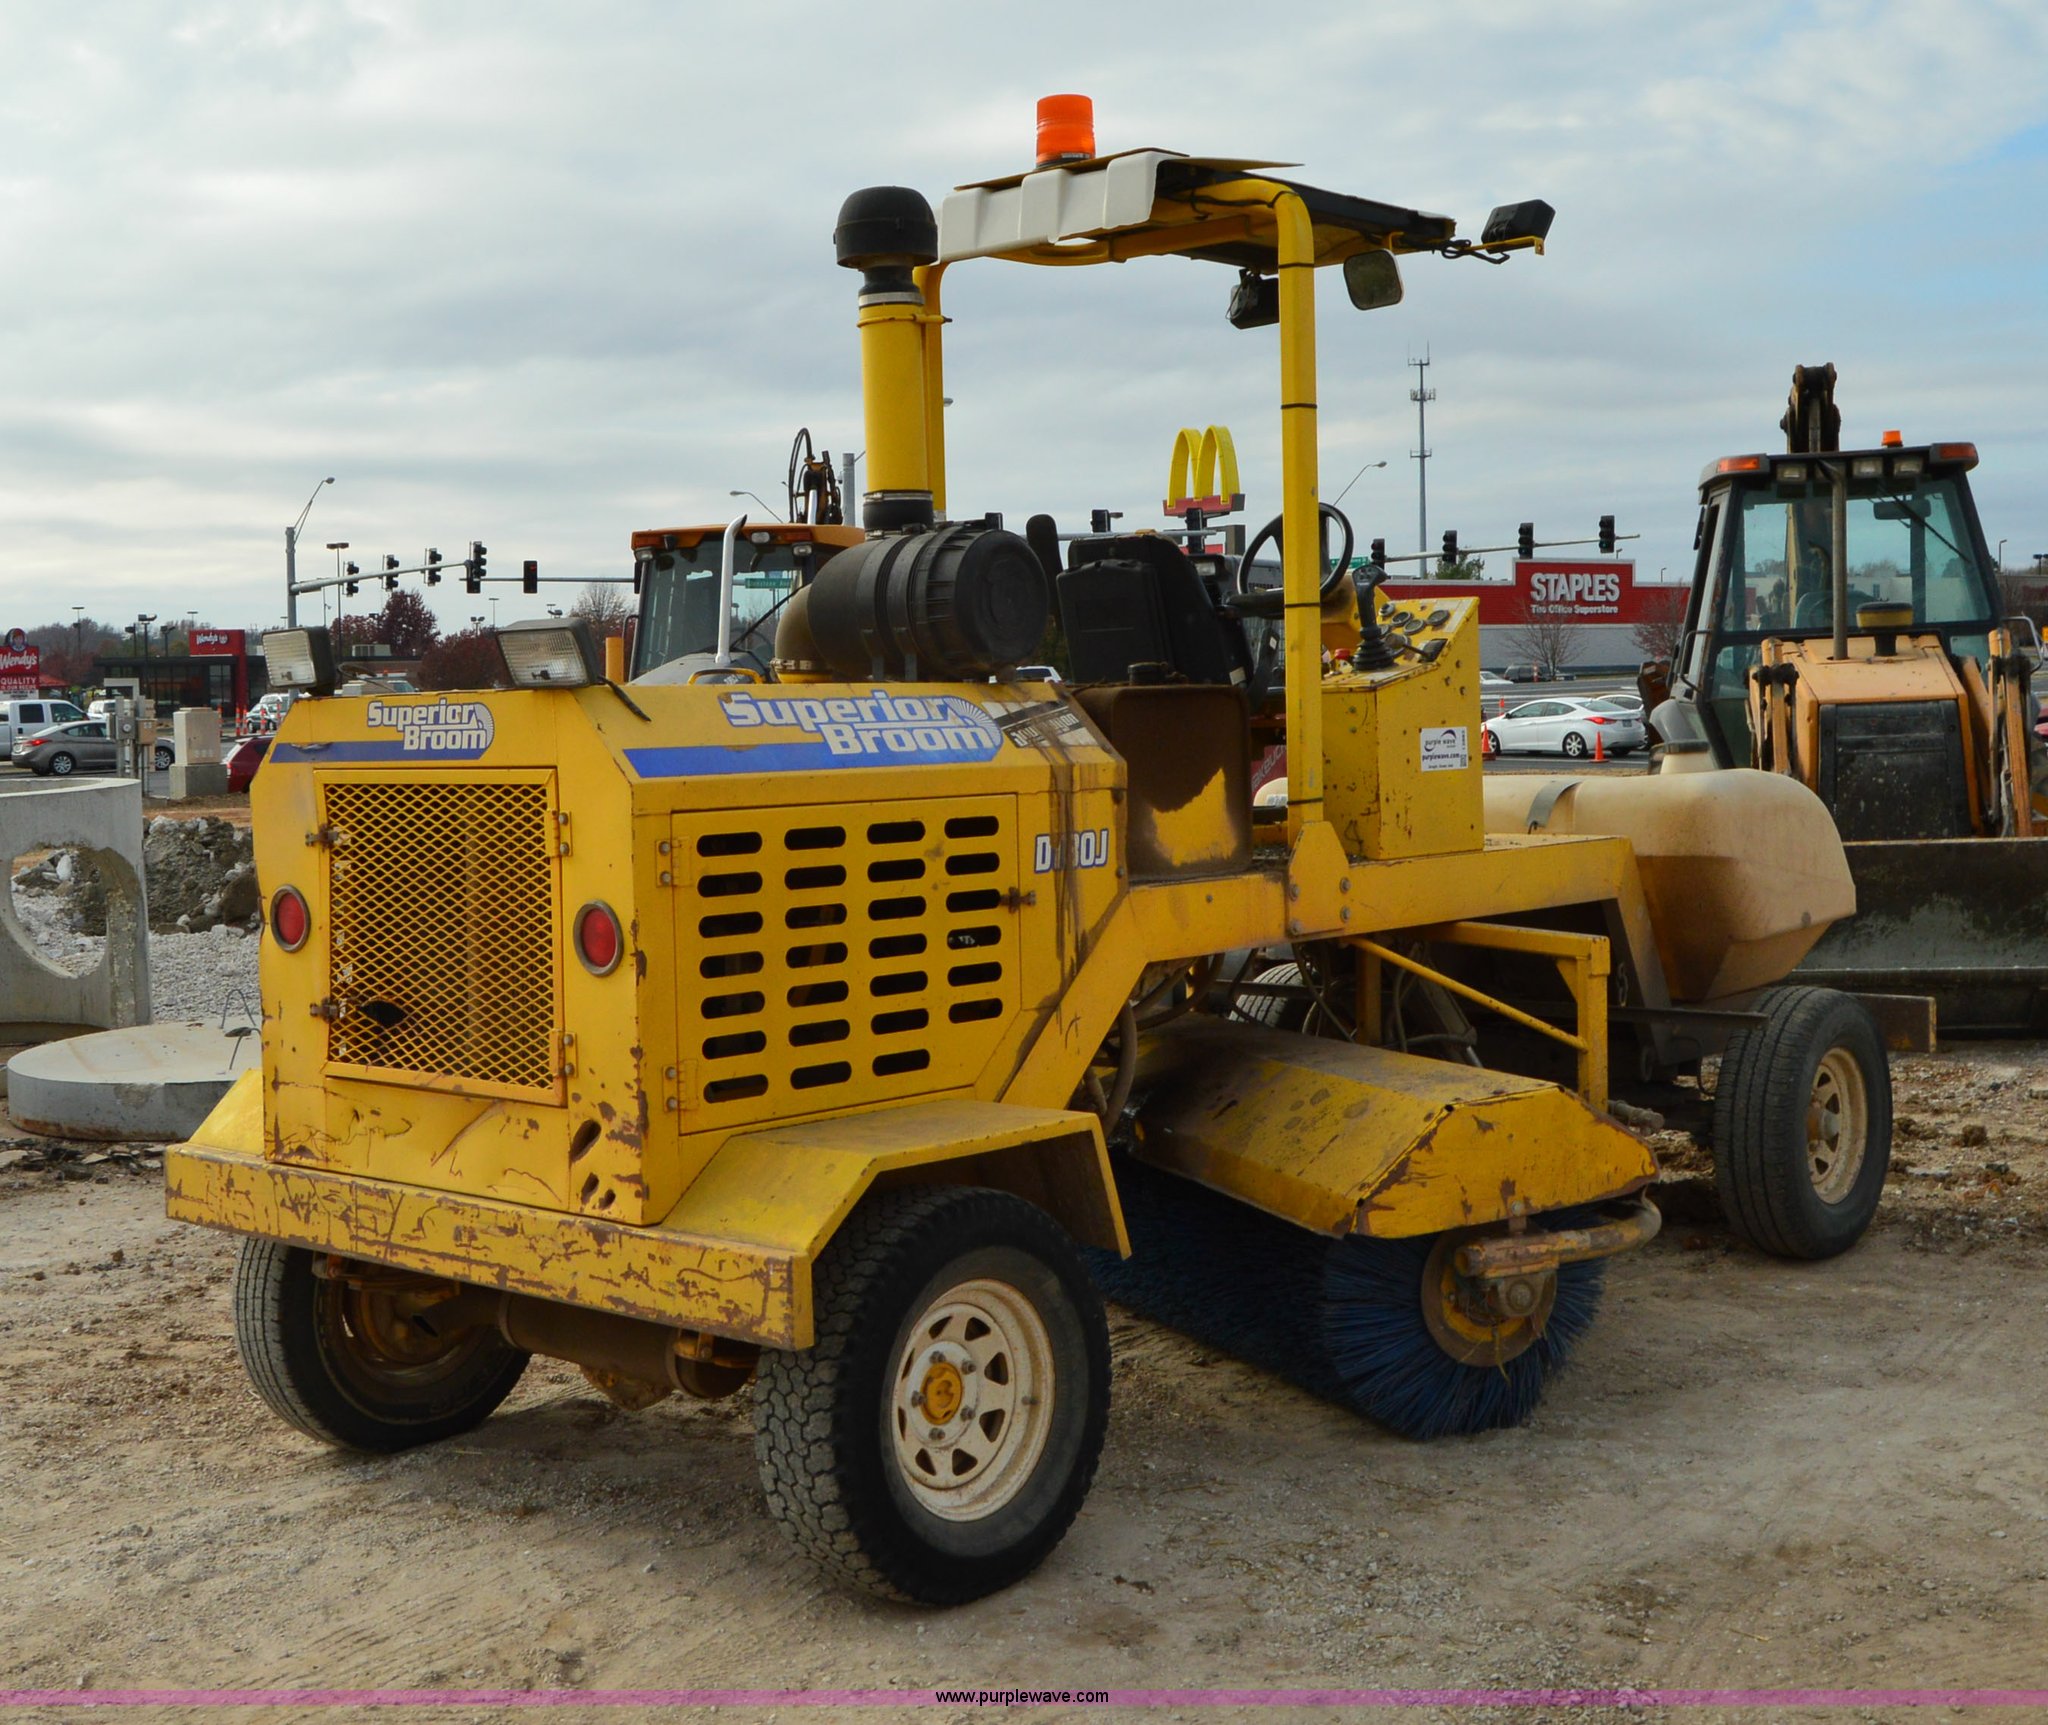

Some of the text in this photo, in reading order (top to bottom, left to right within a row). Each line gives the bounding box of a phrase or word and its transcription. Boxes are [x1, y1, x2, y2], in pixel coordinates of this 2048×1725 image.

[1530, 572, 1620, 602] STAPLES
[1530, 604, 1619, 615] The Office Superstore
[0, 650, 38, 670] Wendy's
[1, 677, 37, 685] QUALITY
[367, 697, 477, 733] Superior
[718, 689, 945, 733] Superior
[403, 724, 488, 750] Broom
[818, 722, 994, 756] Broom
